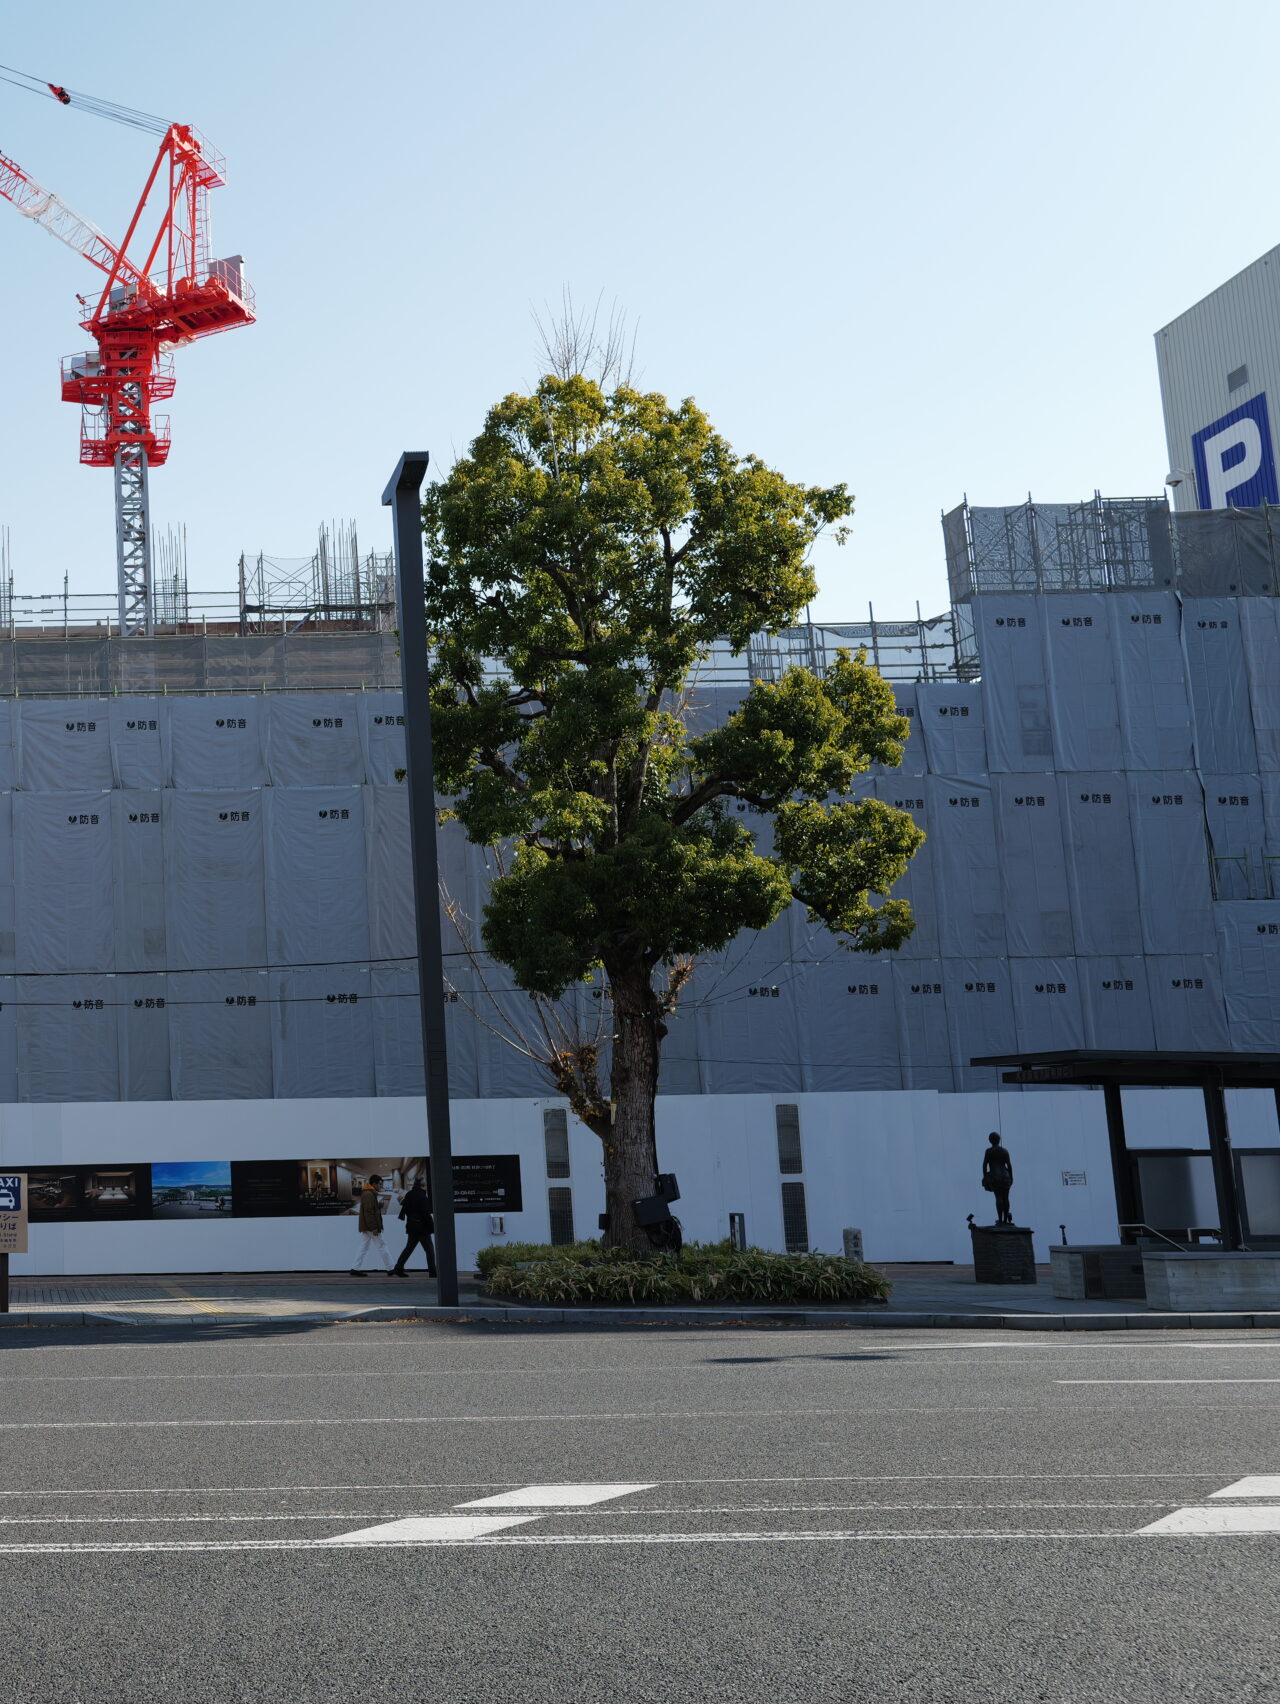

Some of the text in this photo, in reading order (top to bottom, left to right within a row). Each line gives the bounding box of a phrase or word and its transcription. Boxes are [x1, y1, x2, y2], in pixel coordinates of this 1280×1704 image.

[1204, 418, 1262, 509] P
[1007, 618, 1027, 628] 防音
[1073, 617, 1093, 627] 防音
[1142, 614, 1162, 624] 防音
[950, 706, 970, 716] 防音
[77, 722, 97, 732] 防音
[137, 720, 157, 730] 防音
[227, 719, 247, 729] 防音
[323, 718, 343, 728] 防音
[905, 799, 925, 809] 防音
[960, 797, 980, 807] 防音
[1026, 796, 1046, 806] 防音
[1092, 794, 1112, 804] 防音
[1163, 795, 1183, 805] 防音
[1229, 796, 1249, 806] 防音
[79, 814, 99, 824] 防音
[140, 813, 160, 823] 防音
[230, 811, 250, 821] 防音
[330, 809, 350, 819] 防音
[1268, 925, 1280, 935] 防
[922, 984, 942, 994] 防音
[976, 982, 996, 992] 防音
[1046, 983, 1066, 993] 防音
[1114, 980, 1134, 990] 防音
[1183, 979, 1203, 989] 防音
[760, 988, 780, 998] 防音
[859, 985, 879, 995] 防音
[84, 999, 104, 1009] 防音
[145, 998, 165, 1008] 防音
[237, 996, 257, 1006] 防音
[338, 994, 358, 1004] 防音
